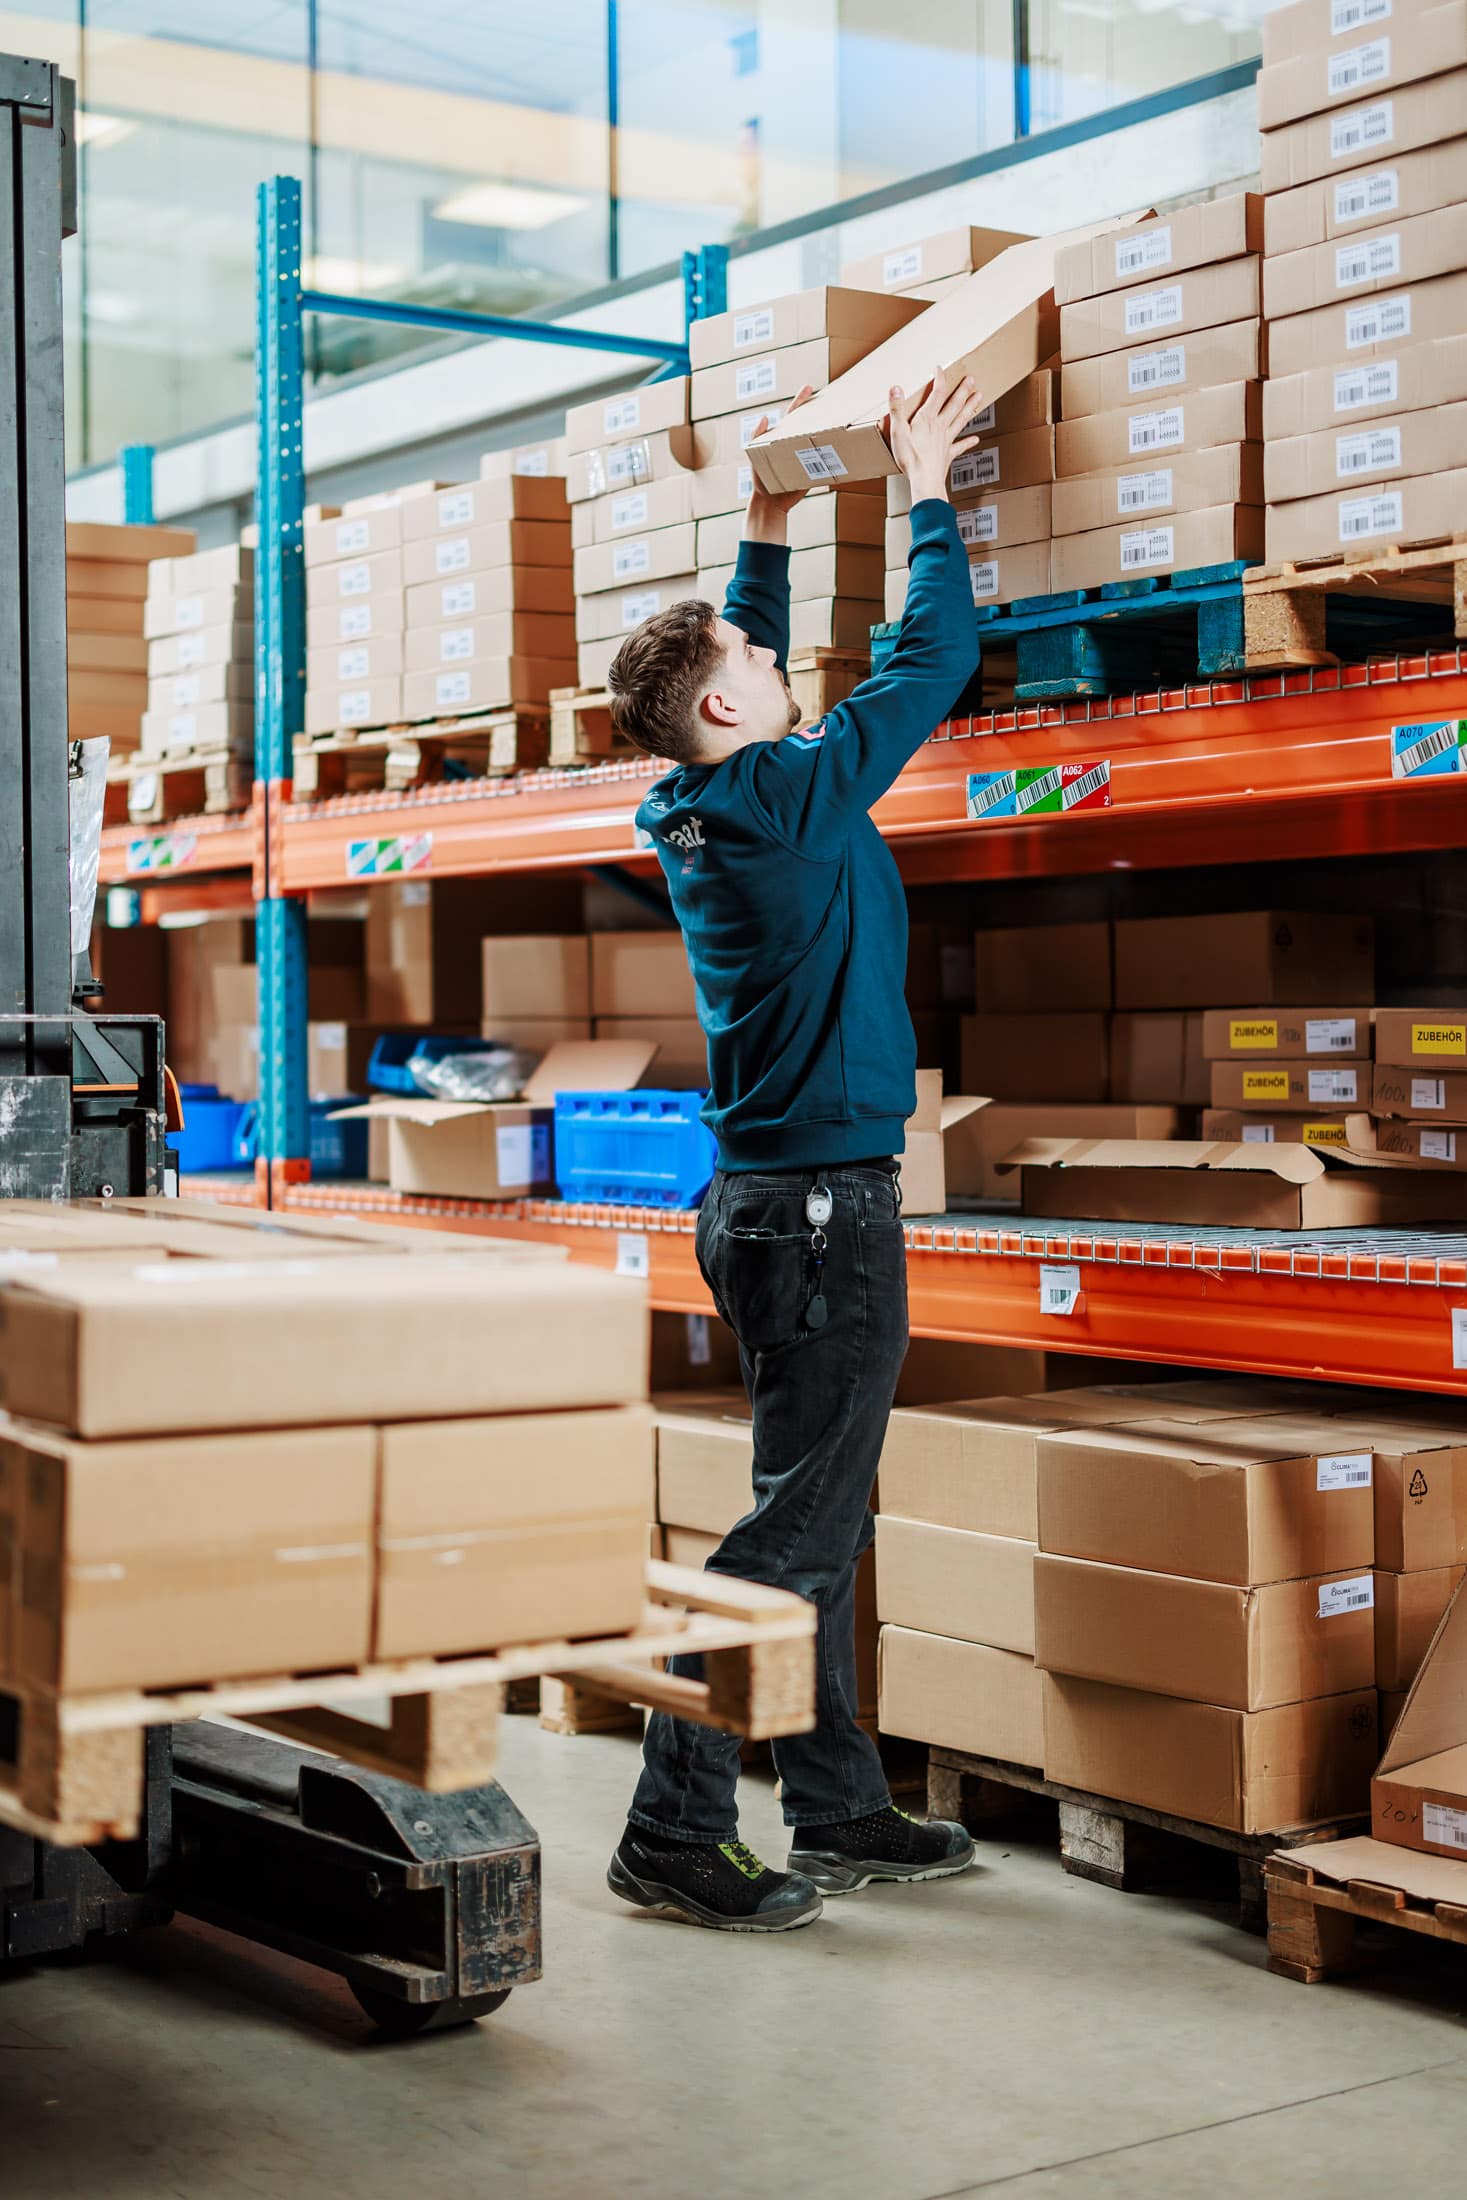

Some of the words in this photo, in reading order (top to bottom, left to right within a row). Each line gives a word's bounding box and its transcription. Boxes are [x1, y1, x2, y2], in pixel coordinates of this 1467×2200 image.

[1399, 726, 1424, 739] A070
[1017, 770, 1036, 781] A061
[1062, 765, 1083, 777] A062
[972, 774, 991, 785] A060
[1103, 795, 1110, 806] 2
[1010, 804, 1015, 813] 0
[1234, 1025, 1274, 1038] ZUBEHÖR
[1417, 1030, 1463, 1042] ZUBEHÖR
[1247, 1076, 1286, 1088] ZUBEHÖR
